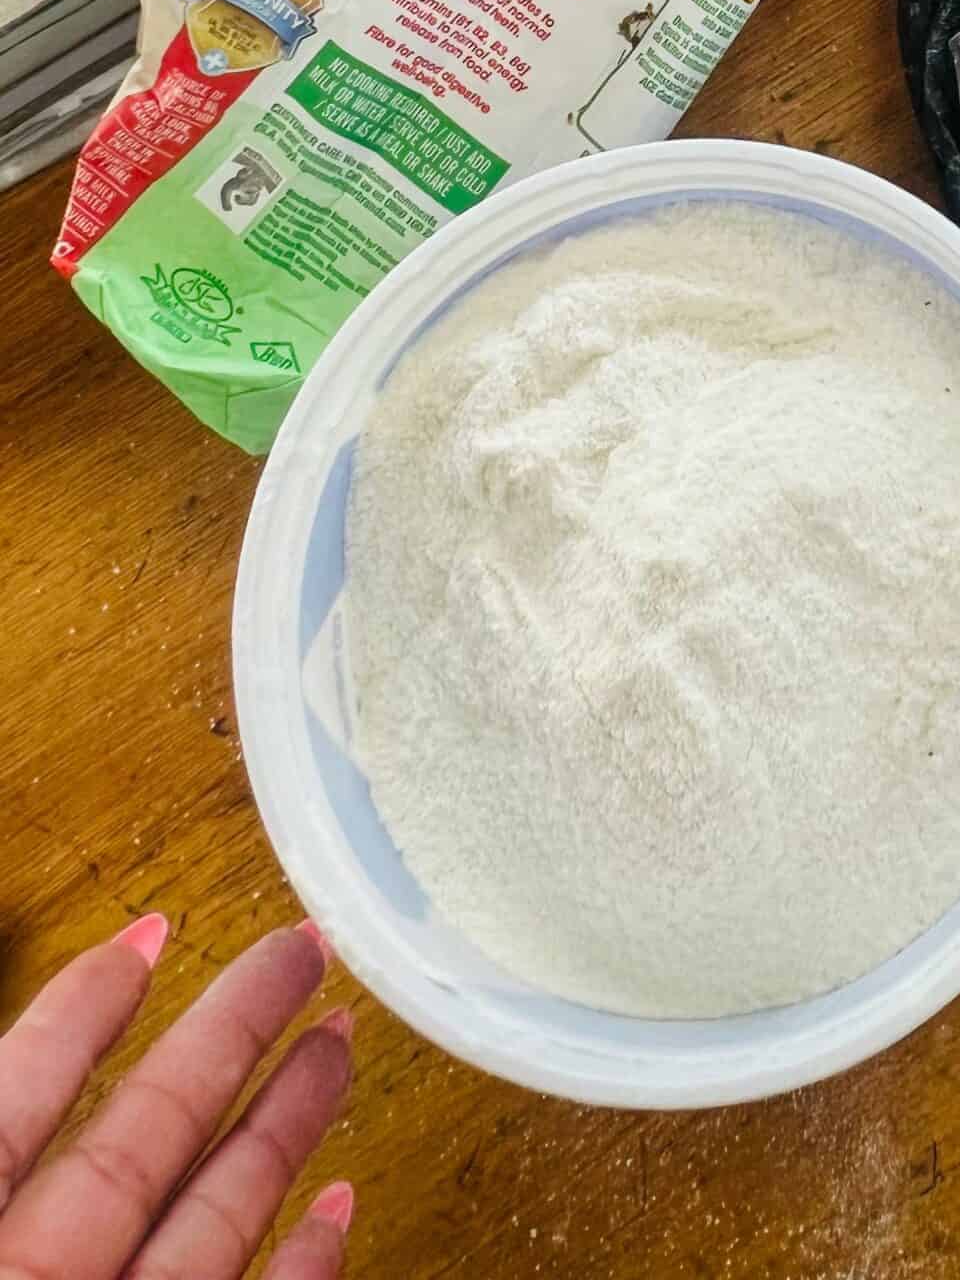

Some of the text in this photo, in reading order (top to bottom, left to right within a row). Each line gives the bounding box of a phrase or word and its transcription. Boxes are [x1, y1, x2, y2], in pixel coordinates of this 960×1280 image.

[396, 12, 437, 45] release
[439, 38, 463, 60] from
[506, 5, 550, 41] normal
[540, 12, 557, 29] to
[366, 22, 492, 114] Fibre for good digestive
[437, 21, 451, 35] to
[450, 29, 488, 61] normal
[484, 58, 528, 94] energy
[307, 66, 337, 93] MILK
[334, 85, 353, 105] OR
[352, 93, 385, 122] WATER
[389, 115, 423, 145] SERVE
[419, 139, 443, 162] HOT
[439, 154, 460, 175] OR
[455, 167, 486, 195] COLD
[322, 101, 358, 132] SERVE
[355, 119, 372, 137] AS
[375, 131, 404, 157] MEAL
[401, 150, 420, 170] OR
[416, 163, 454, 197] SHAKE
[328, 56, 349, 77] NO
[347, 67, 391, 104] COOKING
[390, 92, 440, 133] REQUIRED
[443, 133, 469, 156] JUST
[466, 150, 491, 173] ADD
[66, 207, 100, 237] VINGS
